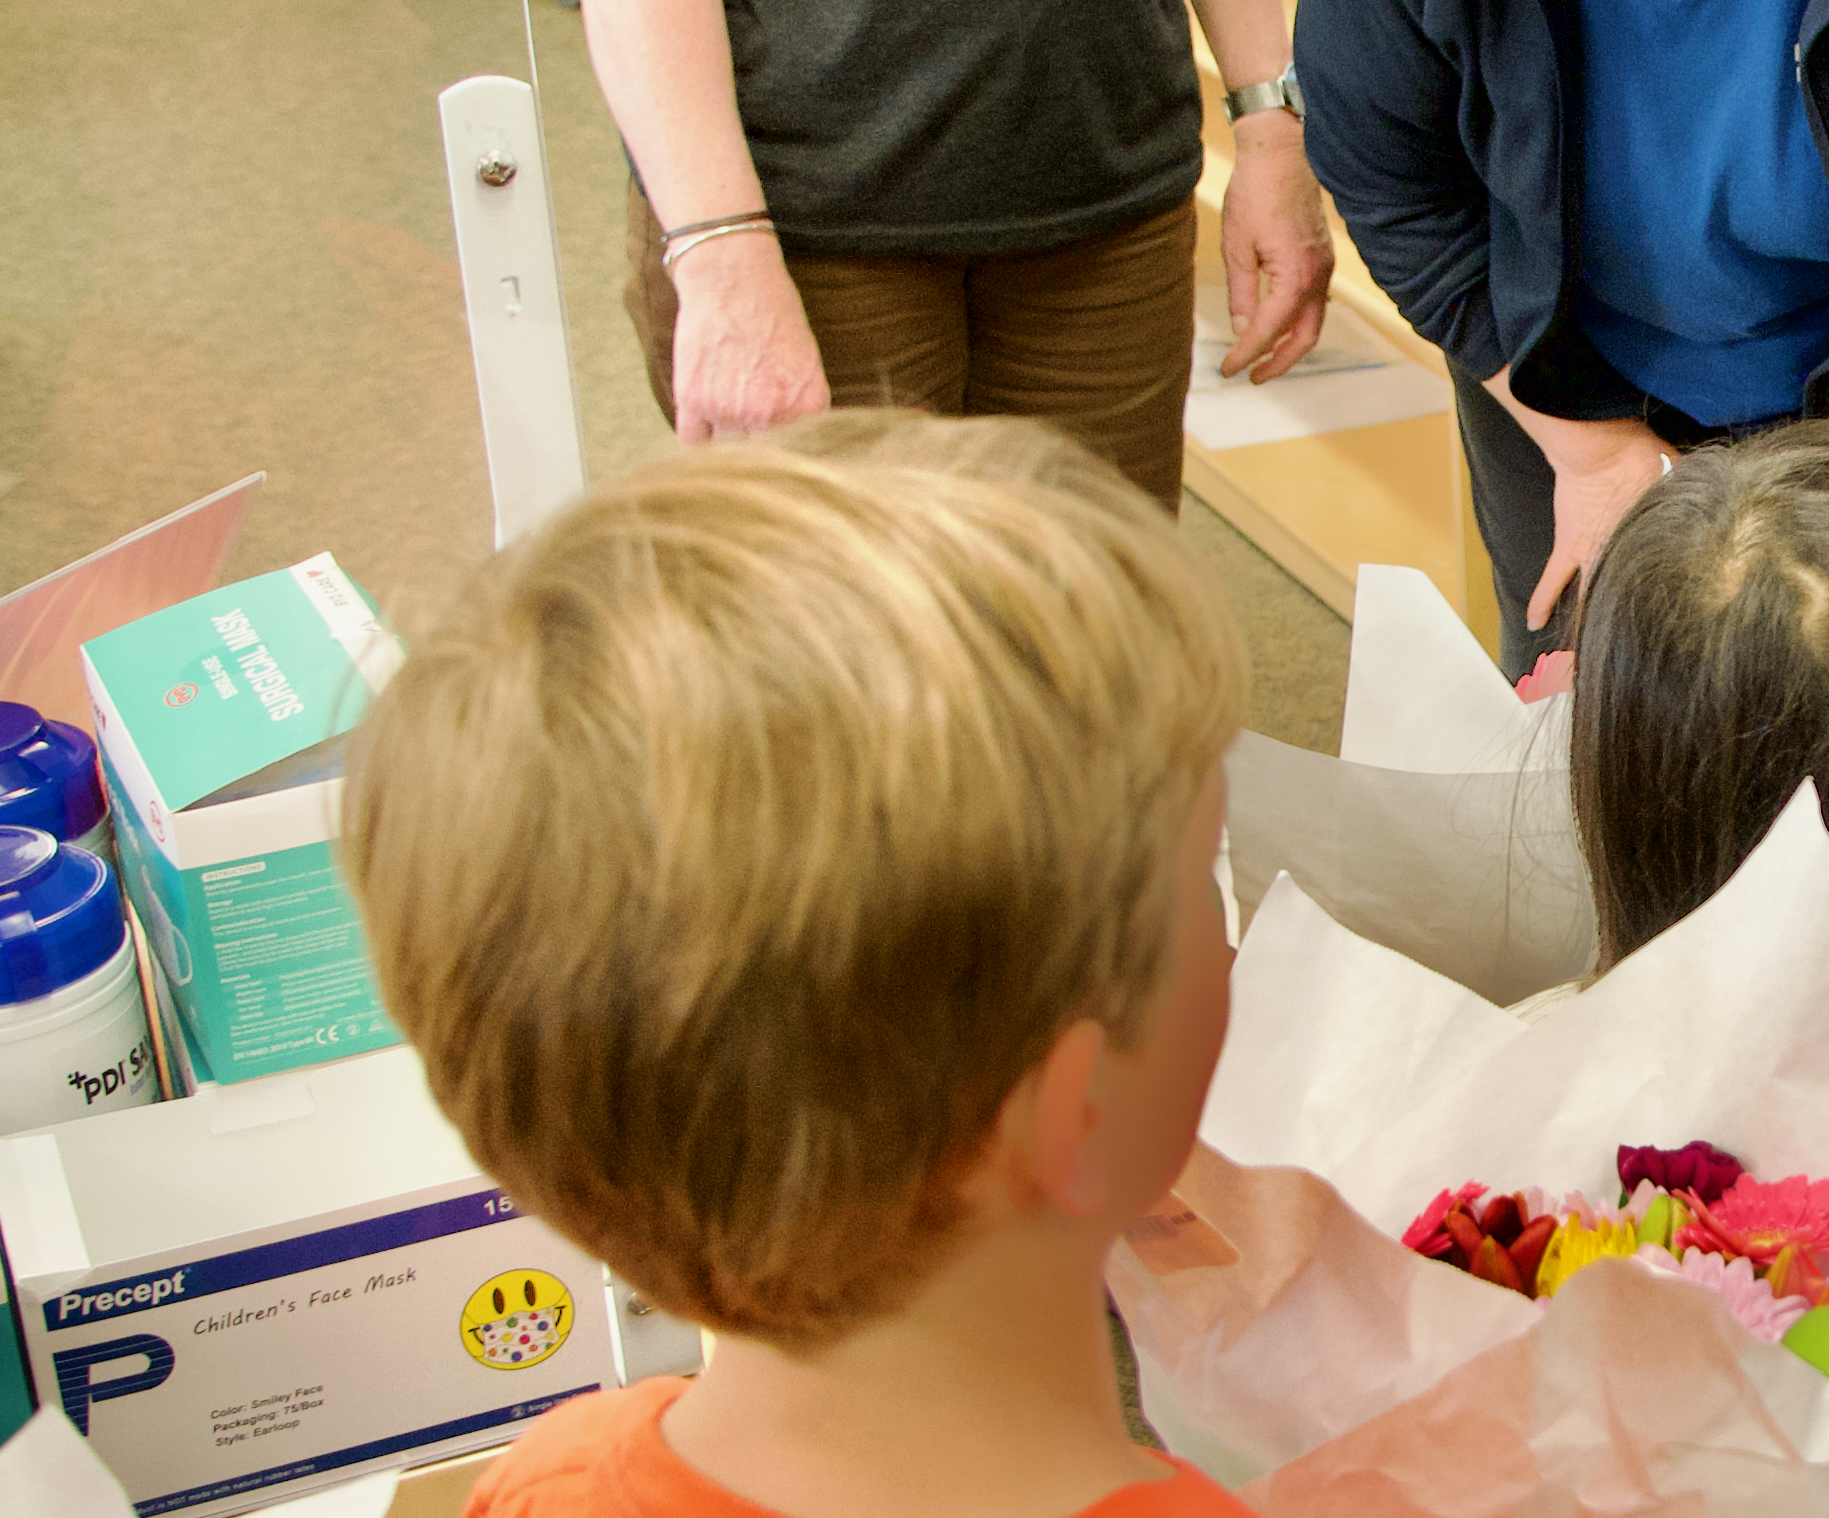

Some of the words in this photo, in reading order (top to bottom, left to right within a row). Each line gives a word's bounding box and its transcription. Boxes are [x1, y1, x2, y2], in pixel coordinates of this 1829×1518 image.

[211, 607, 260, 653] MASK
[237, 644, 304, 722] SURGICAL
[58, 1269, 186, 1322] Precept
[193, 1299, 296, 1337] Children's
[308, 1287, 353, 1309] Face
[363, 1267, 418, 1295] Mask
[210, 1404, 248, 1420] Color:
[250, 1392, 292, 1410] Smiley
[295, 1384, 324, 1399] Face
[212, 1410, 279, 1435] Packaging:
[283, 1398, 325, 1416] 75/Box
[214, 1431, 250, 1448] Style:
[253, 1418, 301, 1439] Earloop
